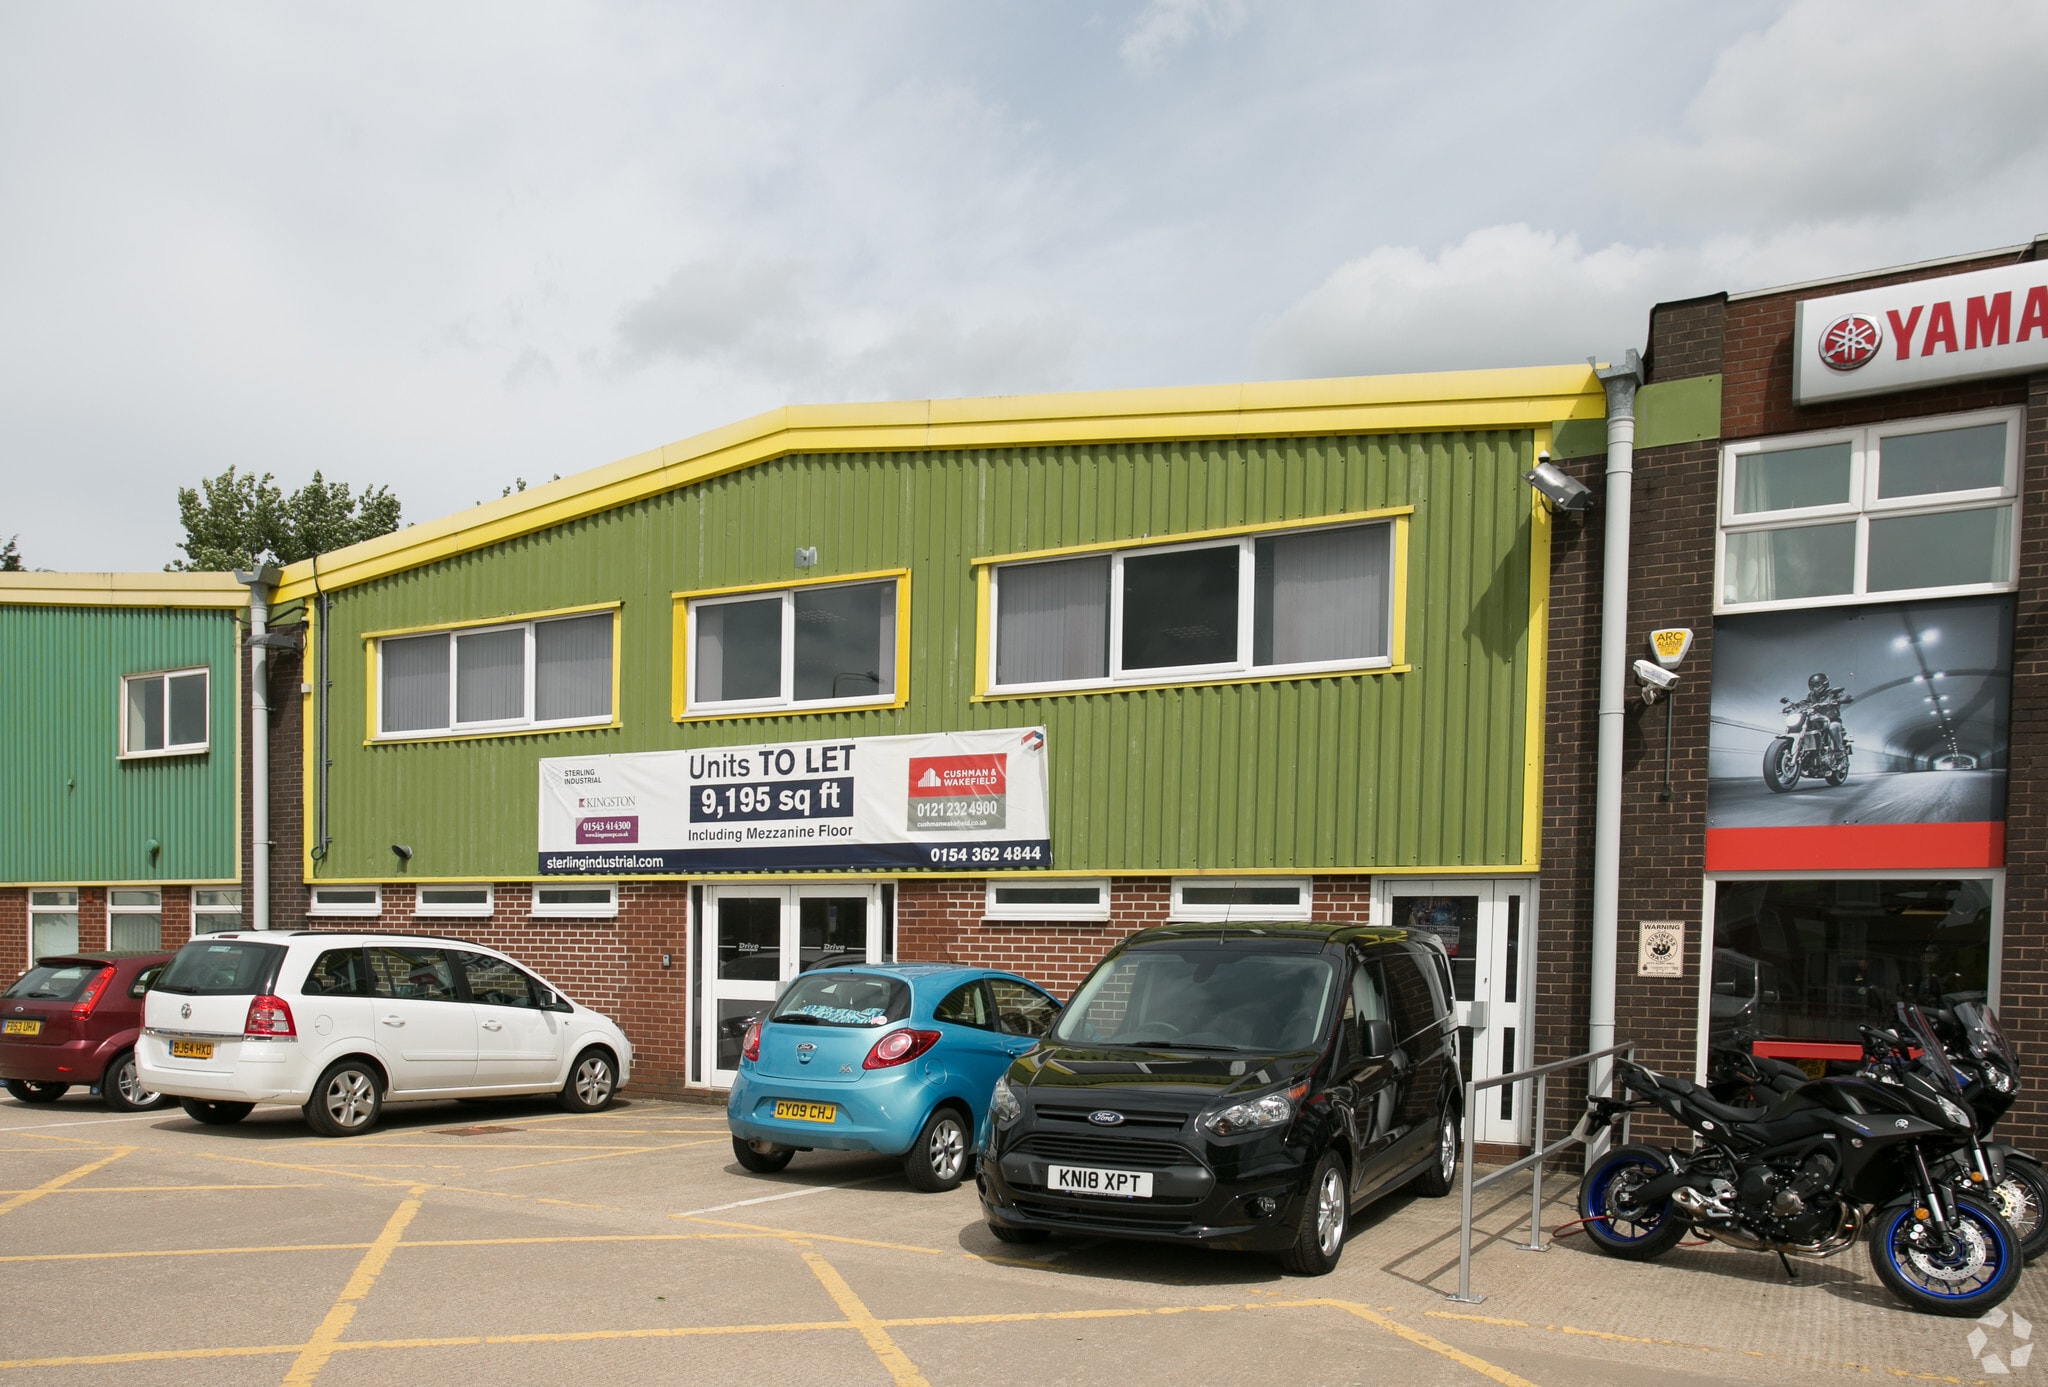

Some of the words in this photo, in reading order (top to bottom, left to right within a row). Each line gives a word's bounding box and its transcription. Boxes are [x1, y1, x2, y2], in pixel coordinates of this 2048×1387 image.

[1656, 631, 1684, 642] ARC
[690, 753, 750, 779] Units
[758, 749, 796, 776] TO
[805, 744, 856, 773] LET
[564, 768, 595, 777] STERLING
[943, 768, 989, 778] CUSHMAN
[990, 768, 997, 777] &
[564, 777, 602, 785] INDUSTRIAL
[943, 776, 997, 786] WAKEFIELD
[586, 796, 636, 808] KINGSTON
[701, 786, 771, 819] 9,195
[778, 789, 811, 817] sq
[819, 781, 841, 809] ft
[917, 802, 944, 817] 0121
[946, 802, 968, 816] 232
[969, 800, 998, 815] 4900
[583, 821, 605, 831] 01543
[605, 820, 631, 831] 414300
[917, 819, 988, 828] cushmanwakefield.co.uk
[688, 829, 742, 842] Including
[746, 826, 815, 839] Mezzanine
[818, 824, 854, 837] Floor
[930, 848, 968, 862] 0154
[971, 847, 1000, 861] 362
[1003, 846, 1042, 860] 4844
[547, 854, 664, 870] sterlingindustrial.com
[1647, 933, 1676, 946] BUSINESS
[173, 1042, 194, 1054] BJ64
[195, 1043, 212, 1056] HXD
[776, 1103, 807, 1117] GY09
[809, 1105, 835, 1120] CHJ
[1094, 1112, 1115, 1122] Ford
[1059, 1169, 1099, 1189] KN18
[1104, 1172, 1141, 1192] XPT
